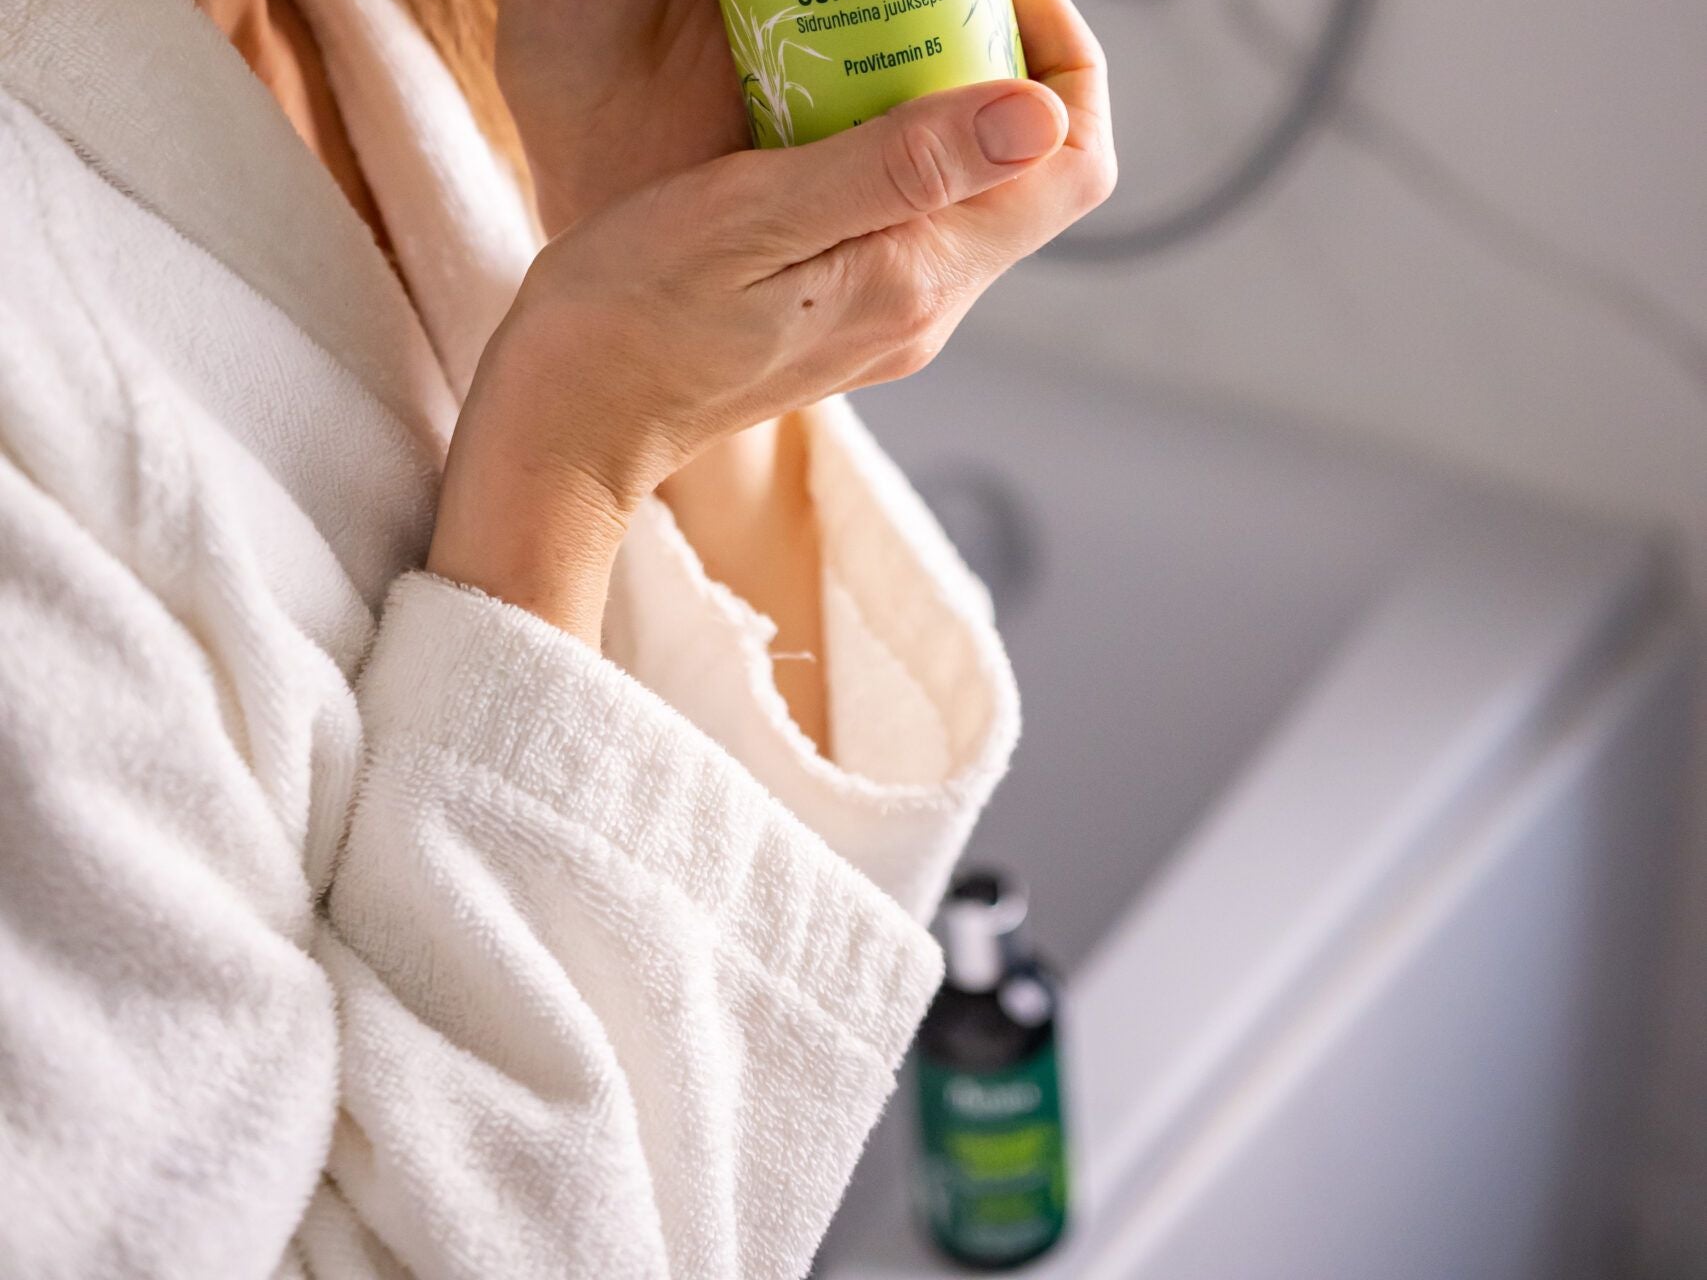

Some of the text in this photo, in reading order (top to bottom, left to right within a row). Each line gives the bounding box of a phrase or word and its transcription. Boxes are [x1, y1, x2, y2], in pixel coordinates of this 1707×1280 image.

[796, 7, 882, 35] Sidrunheina
[843, 36, 943, 77] ProVitamin B5
